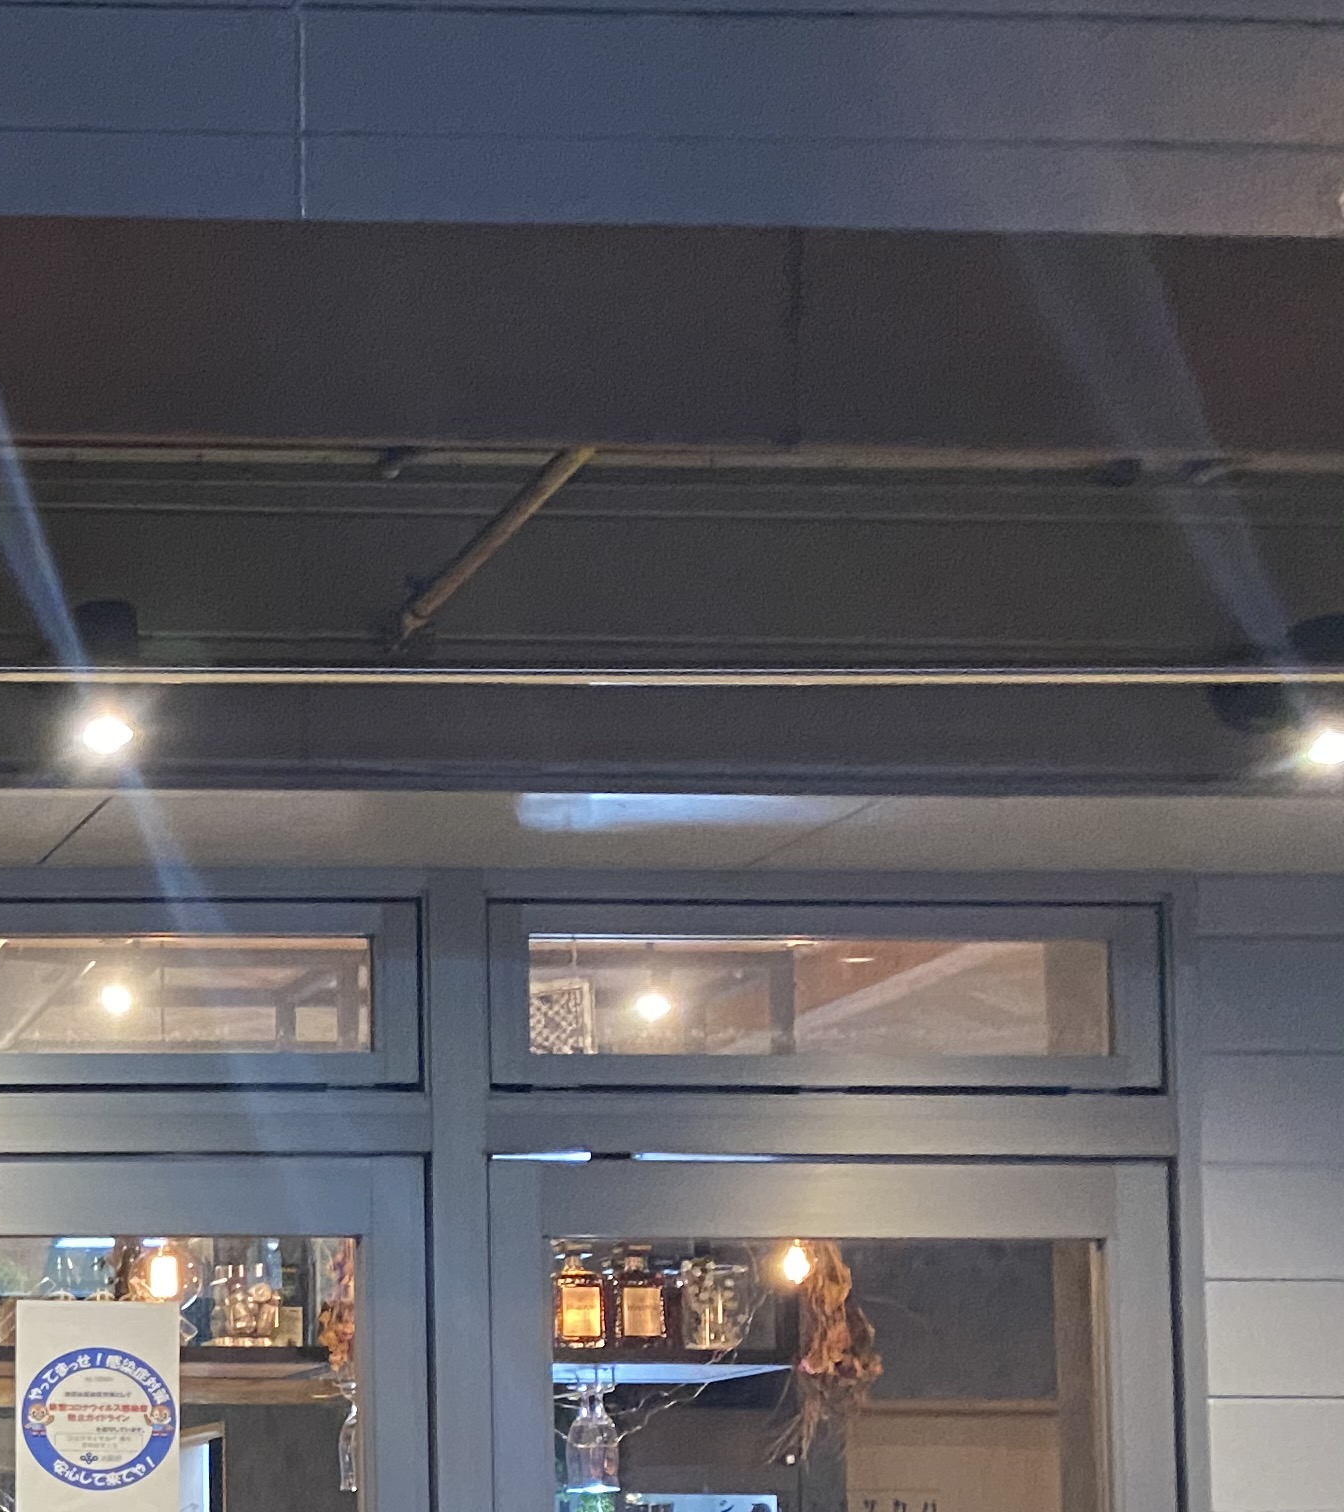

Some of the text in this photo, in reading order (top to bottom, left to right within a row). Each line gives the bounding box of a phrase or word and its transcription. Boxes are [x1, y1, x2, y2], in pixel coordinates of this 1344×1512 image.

[53, 1456, 156, 1487] 安心して来てや！
